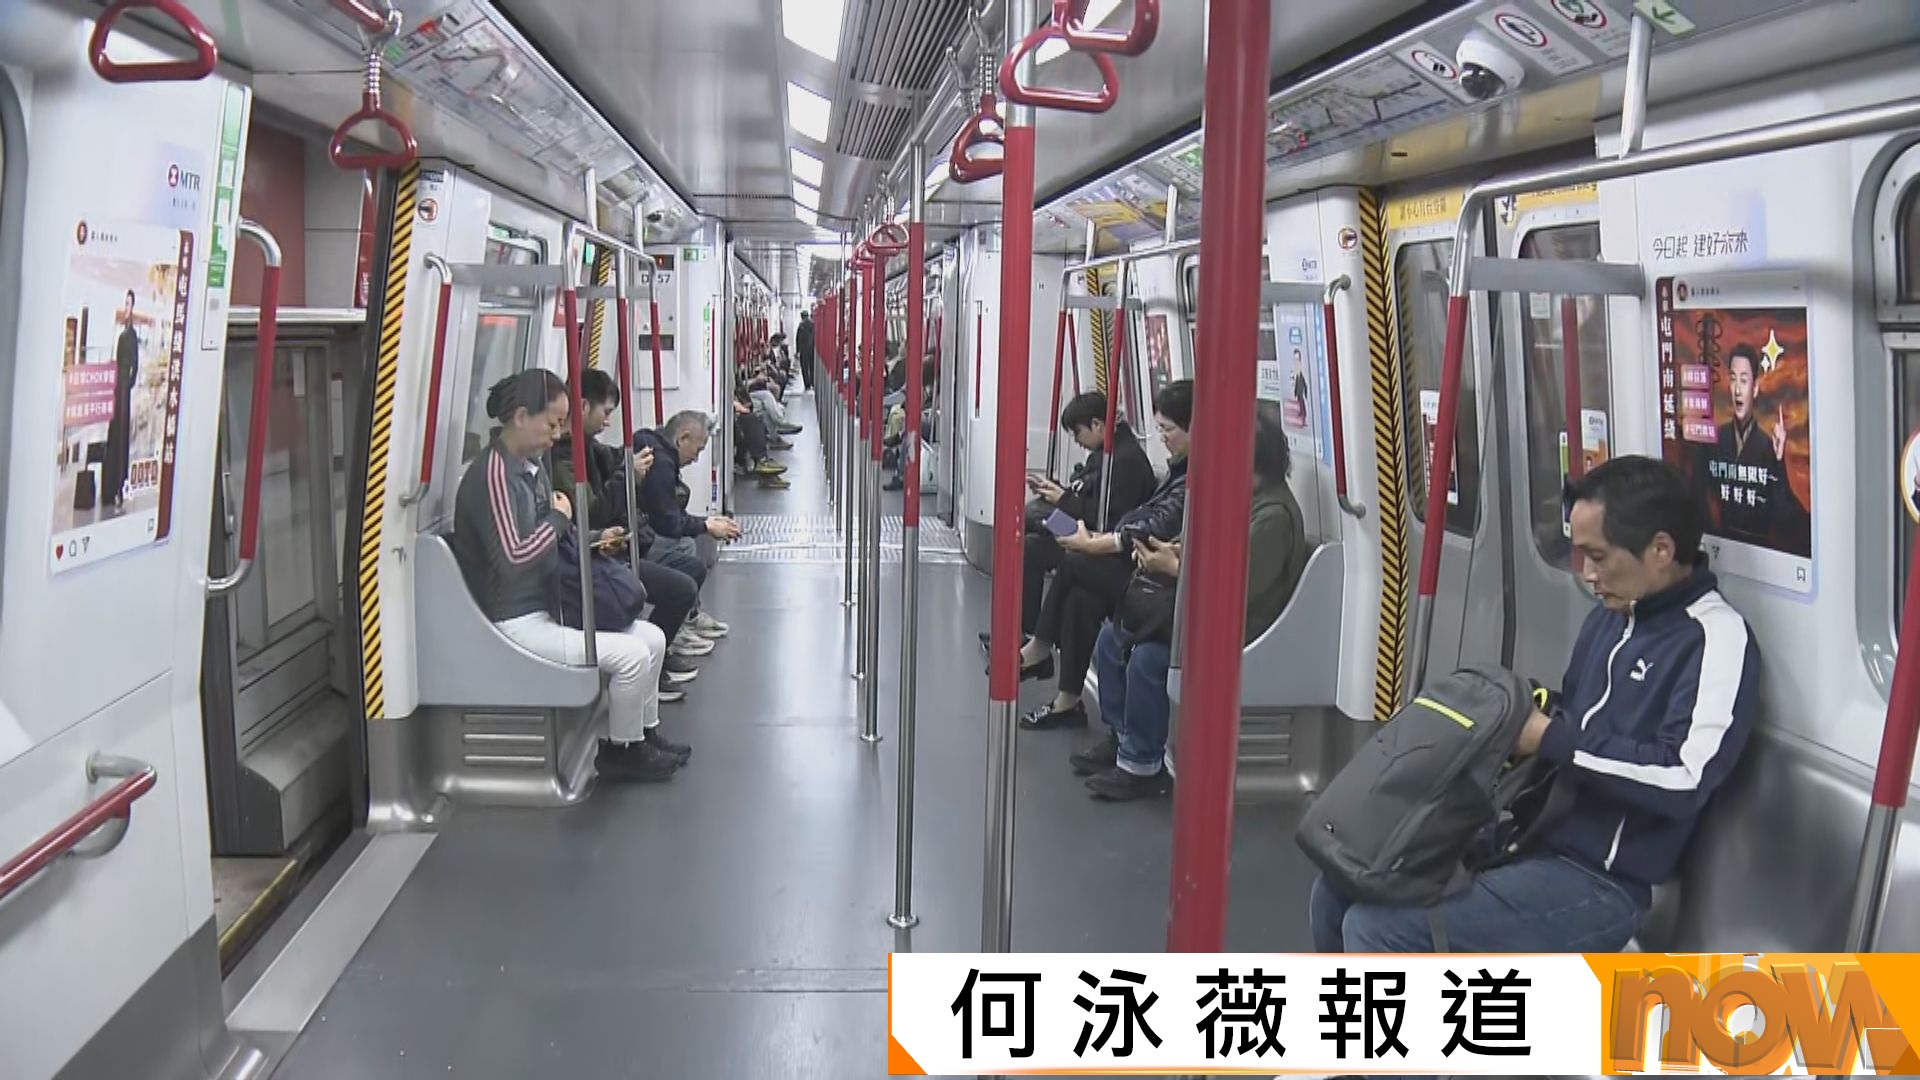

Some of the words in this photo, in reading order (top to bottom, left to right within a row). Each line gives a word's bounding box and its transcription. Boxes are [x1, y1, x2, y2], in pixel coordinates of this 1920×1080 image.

[181, 169, 201, 191] MTR
[1652, 234, 1688, 260] 今日起
[1693, 228, 1749, 257] 建好未來
[641, 273, 671, 284] D57
